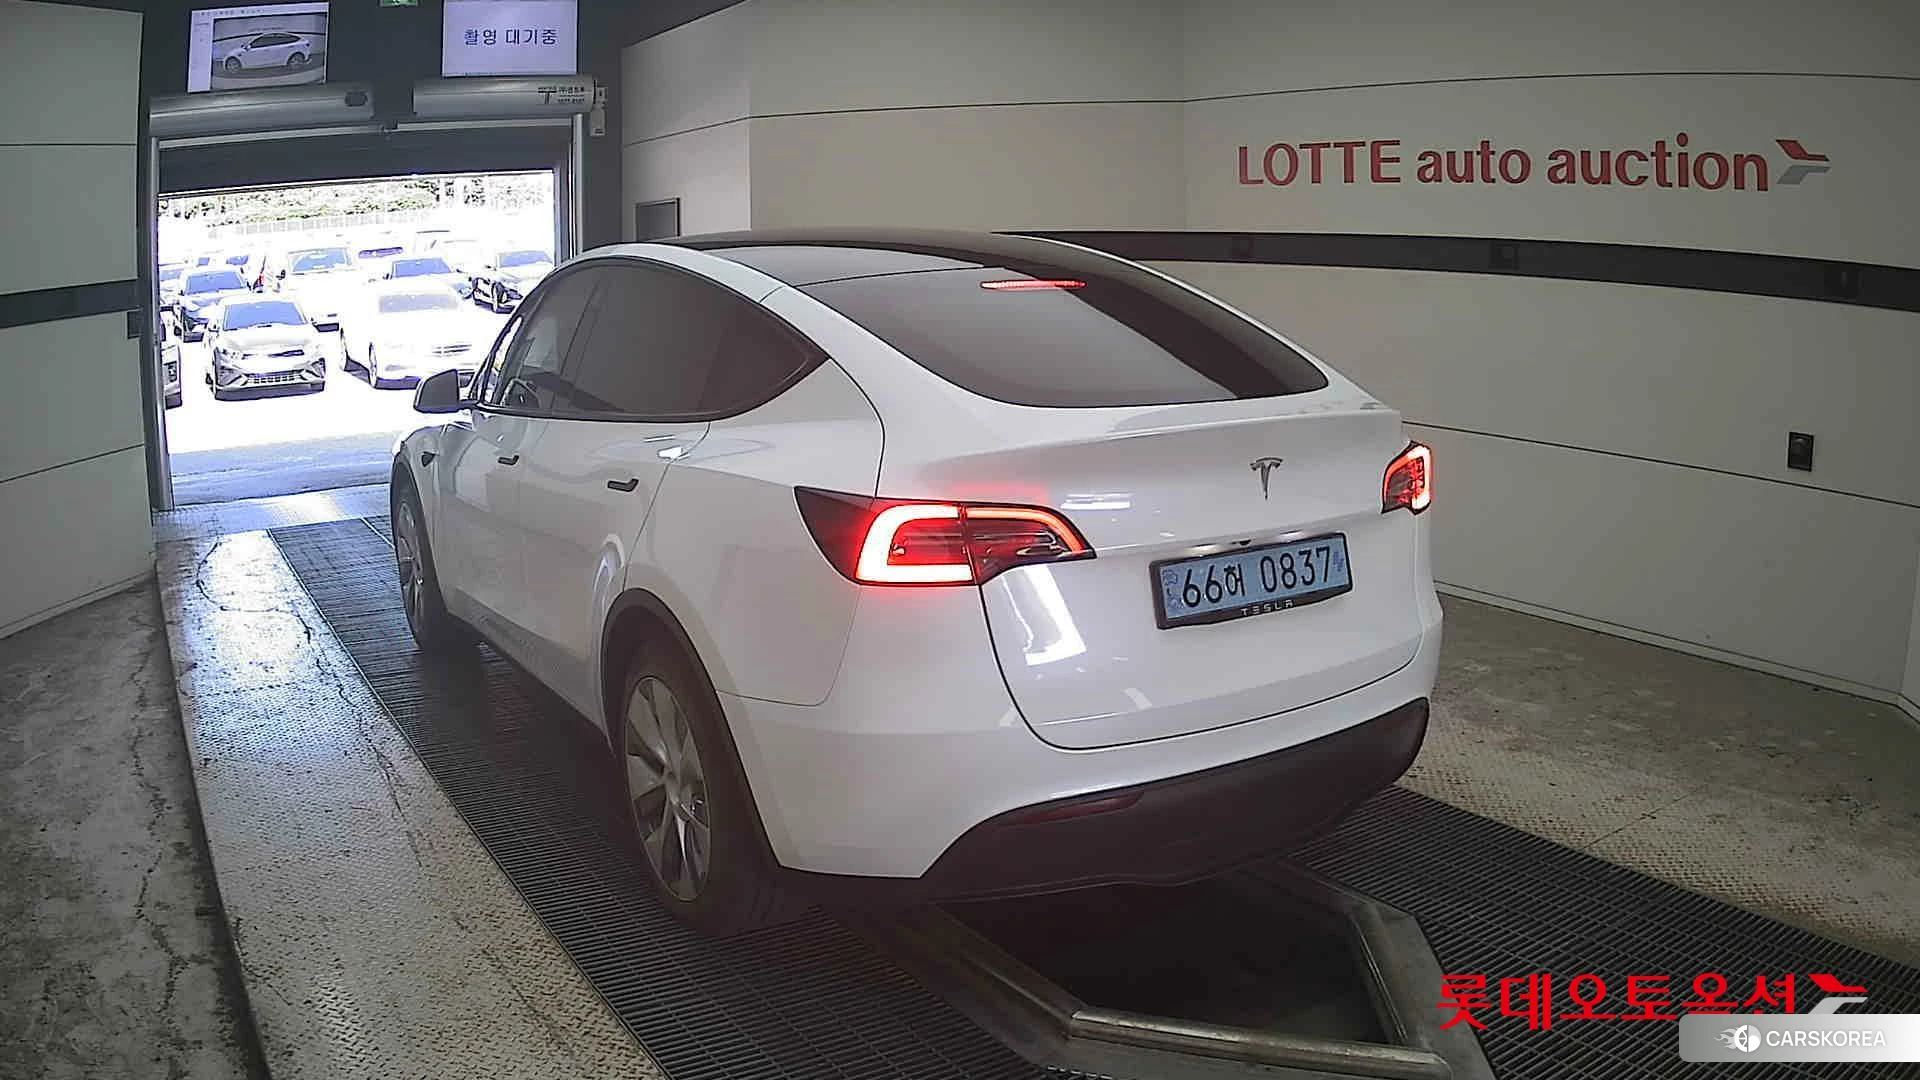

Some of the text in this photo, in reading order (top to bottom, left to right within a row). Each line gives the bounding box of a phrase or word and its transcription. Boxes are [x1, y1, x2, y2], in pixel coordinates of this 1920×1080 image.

[464, 28, 557, 46] 촬영 대기중
[1238, 133, 1769, 191] LOTTE auto auction
[1182, 546, 1331, 607] 66허 0837
[1241, 600, 1294, 617] TESLA
